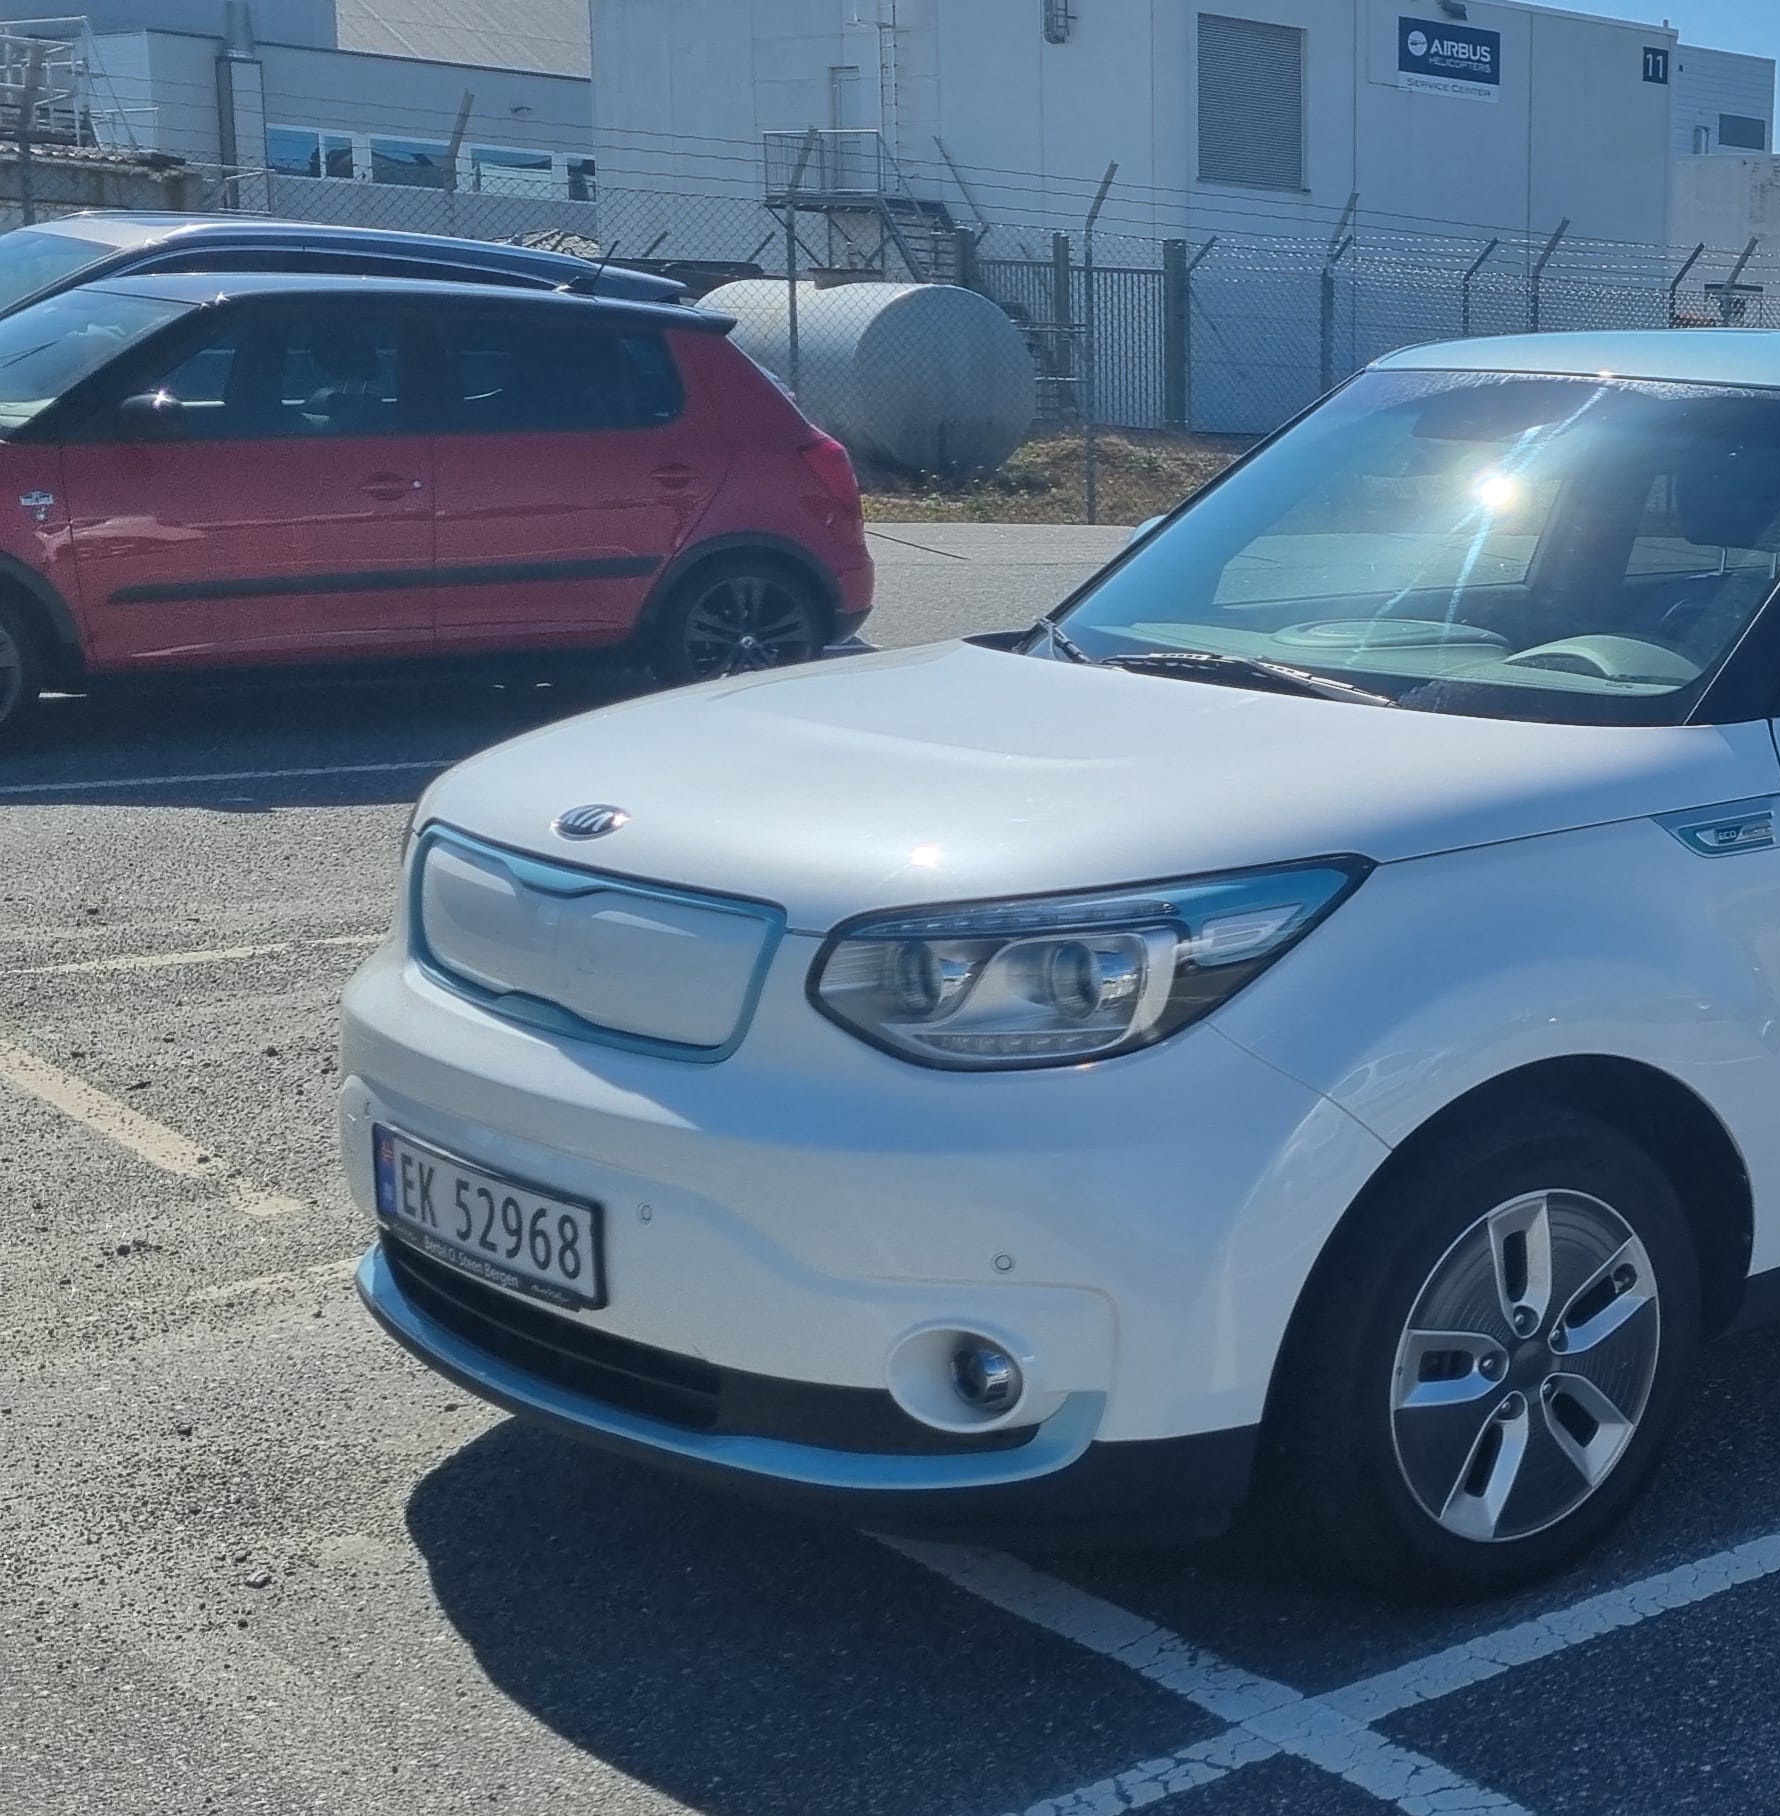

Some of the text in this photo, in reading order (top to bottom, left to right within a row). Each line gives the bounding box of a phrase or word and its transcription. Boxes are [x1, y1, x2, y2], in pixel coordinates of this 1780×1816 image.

[1429, 39, 1492, 63] AIRBUS
[1429, 56, 1491, 73] HELICOPTERS
[1645, 53, 1664, 79] 11
[560, 806, 615, 832] KIA
[400, 1154, 582, 1281] EK 52968
[484, 1262, 519, 1289] Bergen
